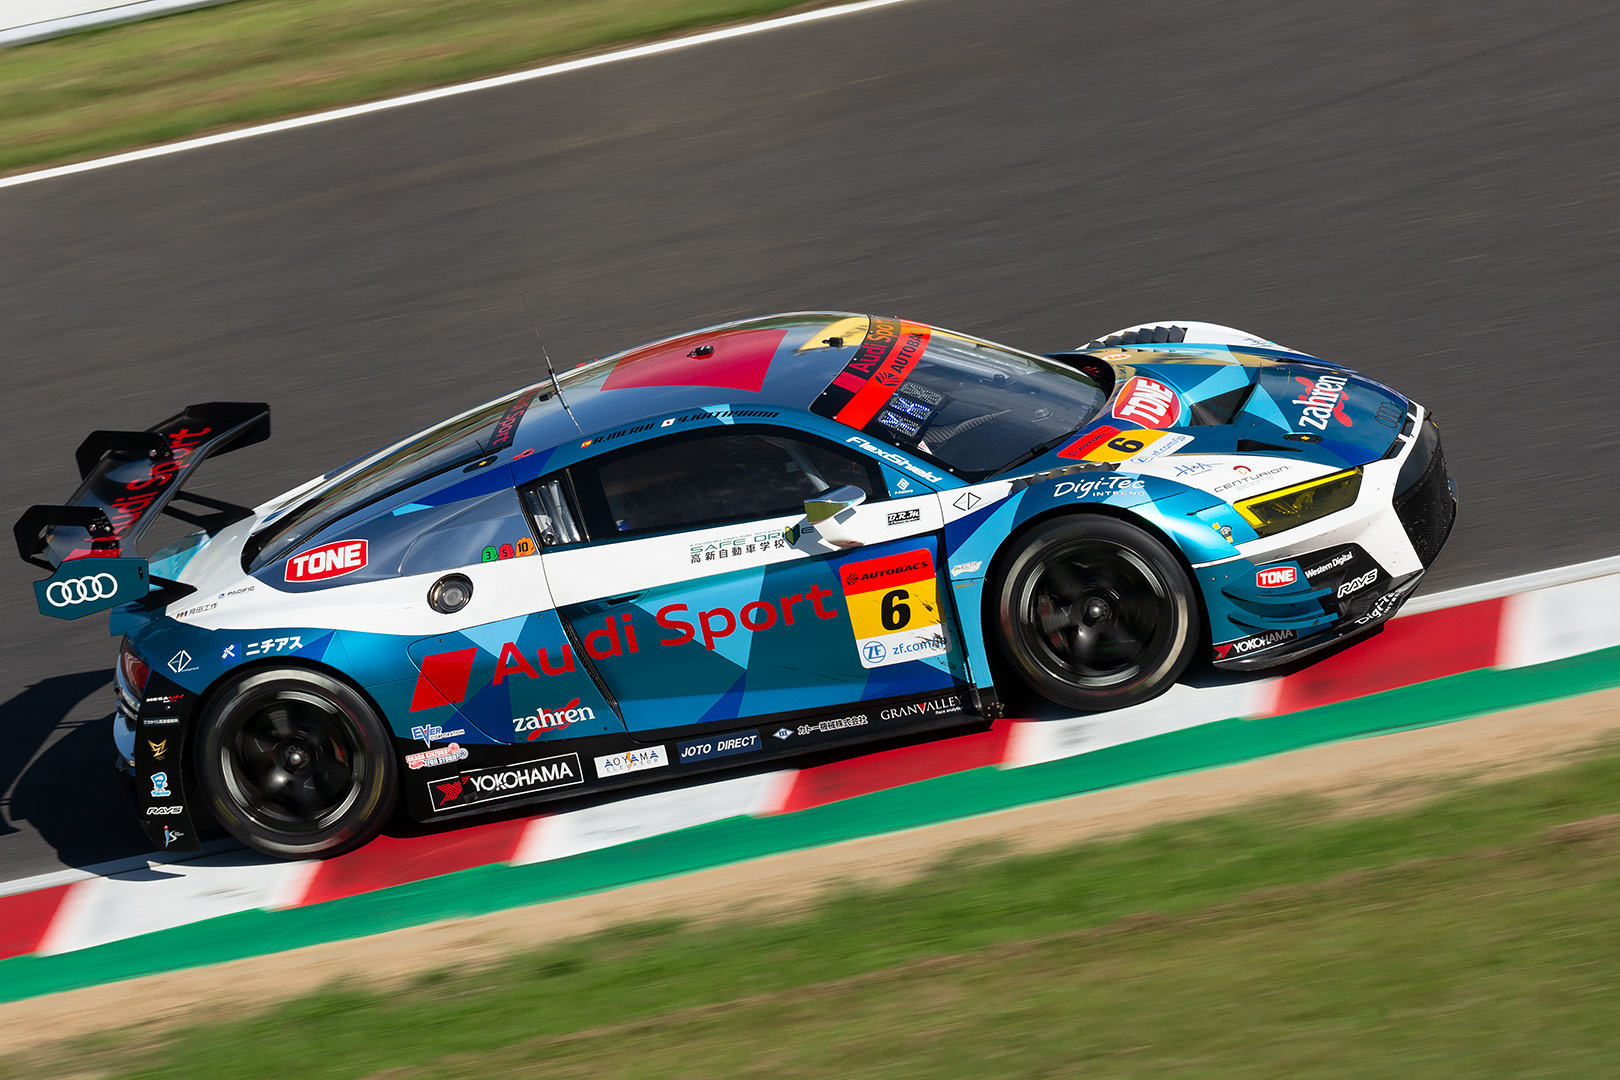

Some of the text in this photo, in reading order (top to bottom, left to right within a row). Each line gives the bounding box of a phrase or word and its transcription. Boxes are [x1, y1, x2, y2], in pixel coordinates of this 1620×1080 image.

[849, 342, 888, 373] Audi
[1119, 379, 1174, 424] TONE
[1291, 375, 1348, 430] zahren
[492, 409, 525, 446] Sport
[1107, 437, 1145, 453] 6
[845, 436, 943, 483] FlexiShield
[1053, 476, 1145, 499] Digi-Tec
[1214, 465, 1289, 493] CENTURION
[517, 541, 529, 553] 10
[690, 537, 746, 554] SAFE
[690, 538, 785, 564] 高新自動車学校
[292, 543, 362, 578] TONE
[860, 561, 928, 580] AUTOBACS
[1305, 551, 1354, 579] Western Digital
[1259, 569, 1295, 585] TONE
[1337, 568, 1378, 598] RAYS
[881, 589, 911, 631] 6
[246, 636, 304, 656] ニチアス
[492, 584, 839, 686] Audi Sport
[1233, 629, 1294, 654] YOKOHAMA
[512, 705, 596, 733] zahren
[880, 695, 963, 720] GRANVALLEY
[681, 735, 757, 758] JOTO DIRECT
[470, 761, 574, 793] YOKOHAMA
[146, 806, 183, 815] RAYS
